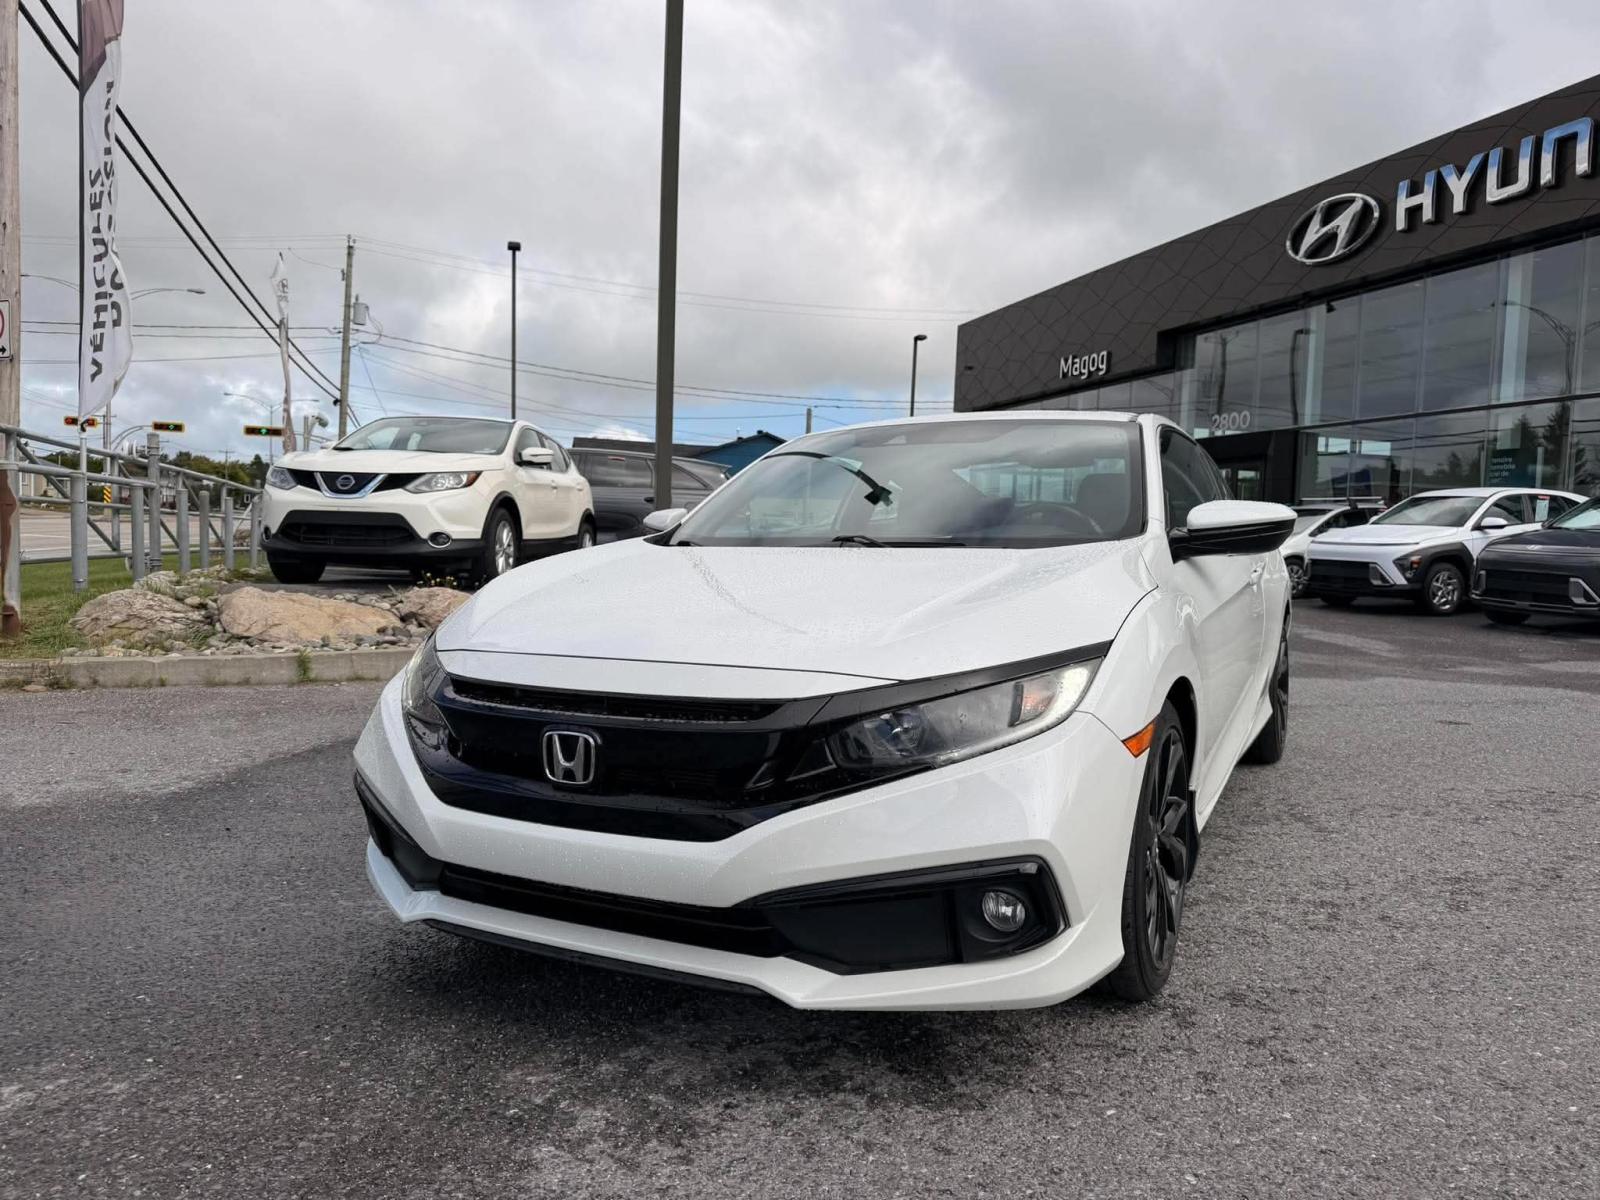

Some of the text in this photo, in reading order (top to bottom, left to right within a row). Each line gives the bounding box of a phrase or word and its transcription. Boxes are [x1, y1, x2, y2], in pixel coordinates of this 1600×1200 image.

[1396, 117, 1595, 232] HYUN
[1059, 350, 1107, 380] Magog
[1211, 410, 1251, 431] 2800
